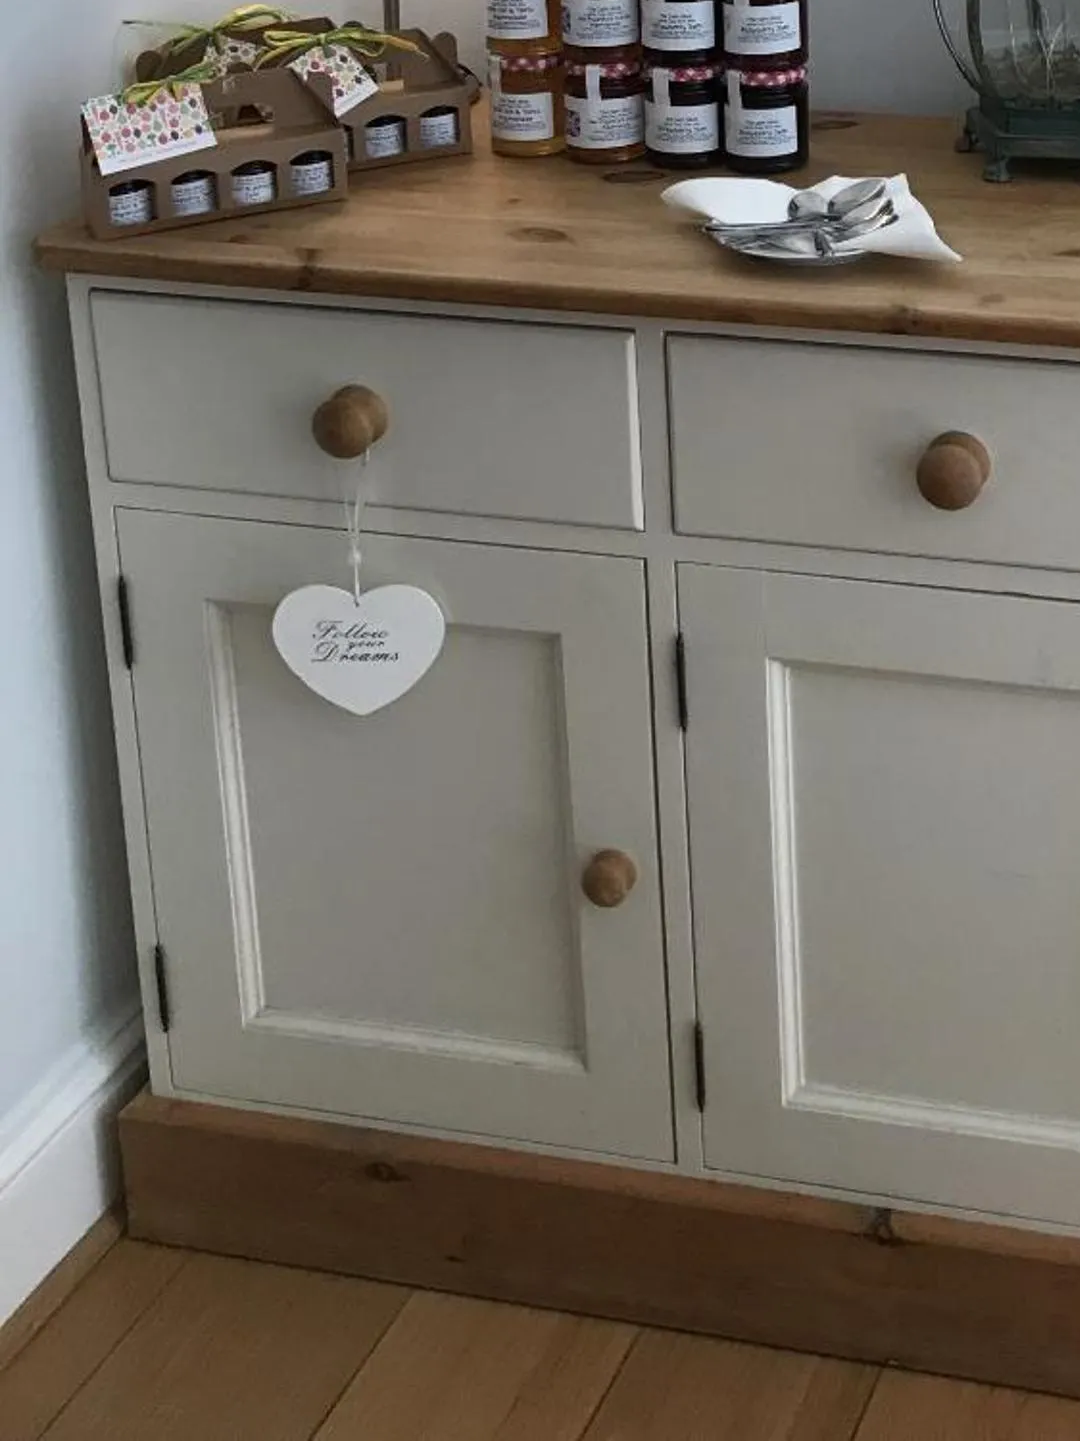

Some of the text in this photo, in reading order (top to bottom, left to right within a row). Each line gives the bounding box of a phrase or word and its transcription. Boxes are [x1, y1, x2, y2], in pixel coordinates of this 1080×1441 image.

[312, 620, 390, 639] Follow
[311, 640, 399, 663] Dreams
[347, 640, 386, 651] your
